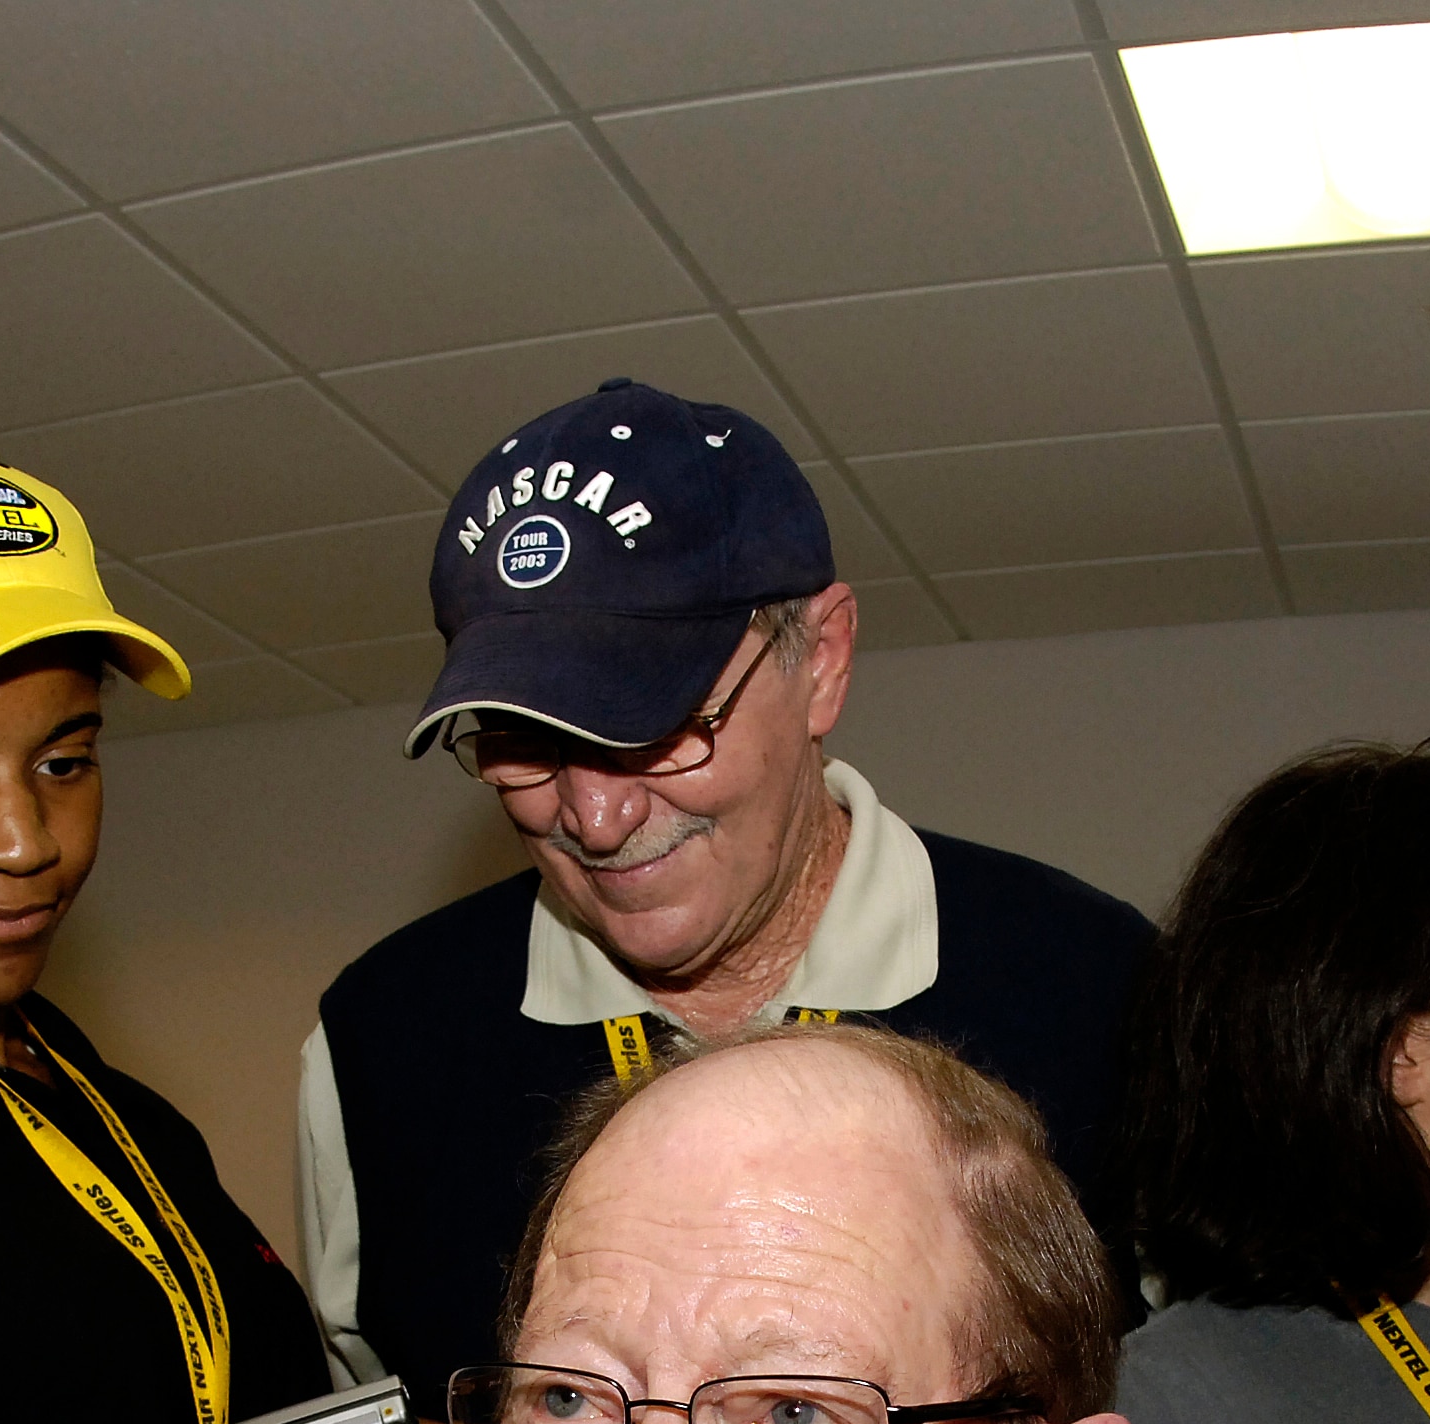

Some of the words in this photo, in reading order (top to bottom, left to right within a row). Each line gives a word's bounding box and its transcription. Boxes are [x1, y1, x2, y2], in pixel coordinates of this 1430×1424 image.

[457, 460, 653, 555] NASCAR
[512, 531, 549, 549] TOUR
[509, 552, 547, 572] 2003
[86, 1183, 146, 1250] Series
[1373, 1312, 1430, 1381] NEXTEL
